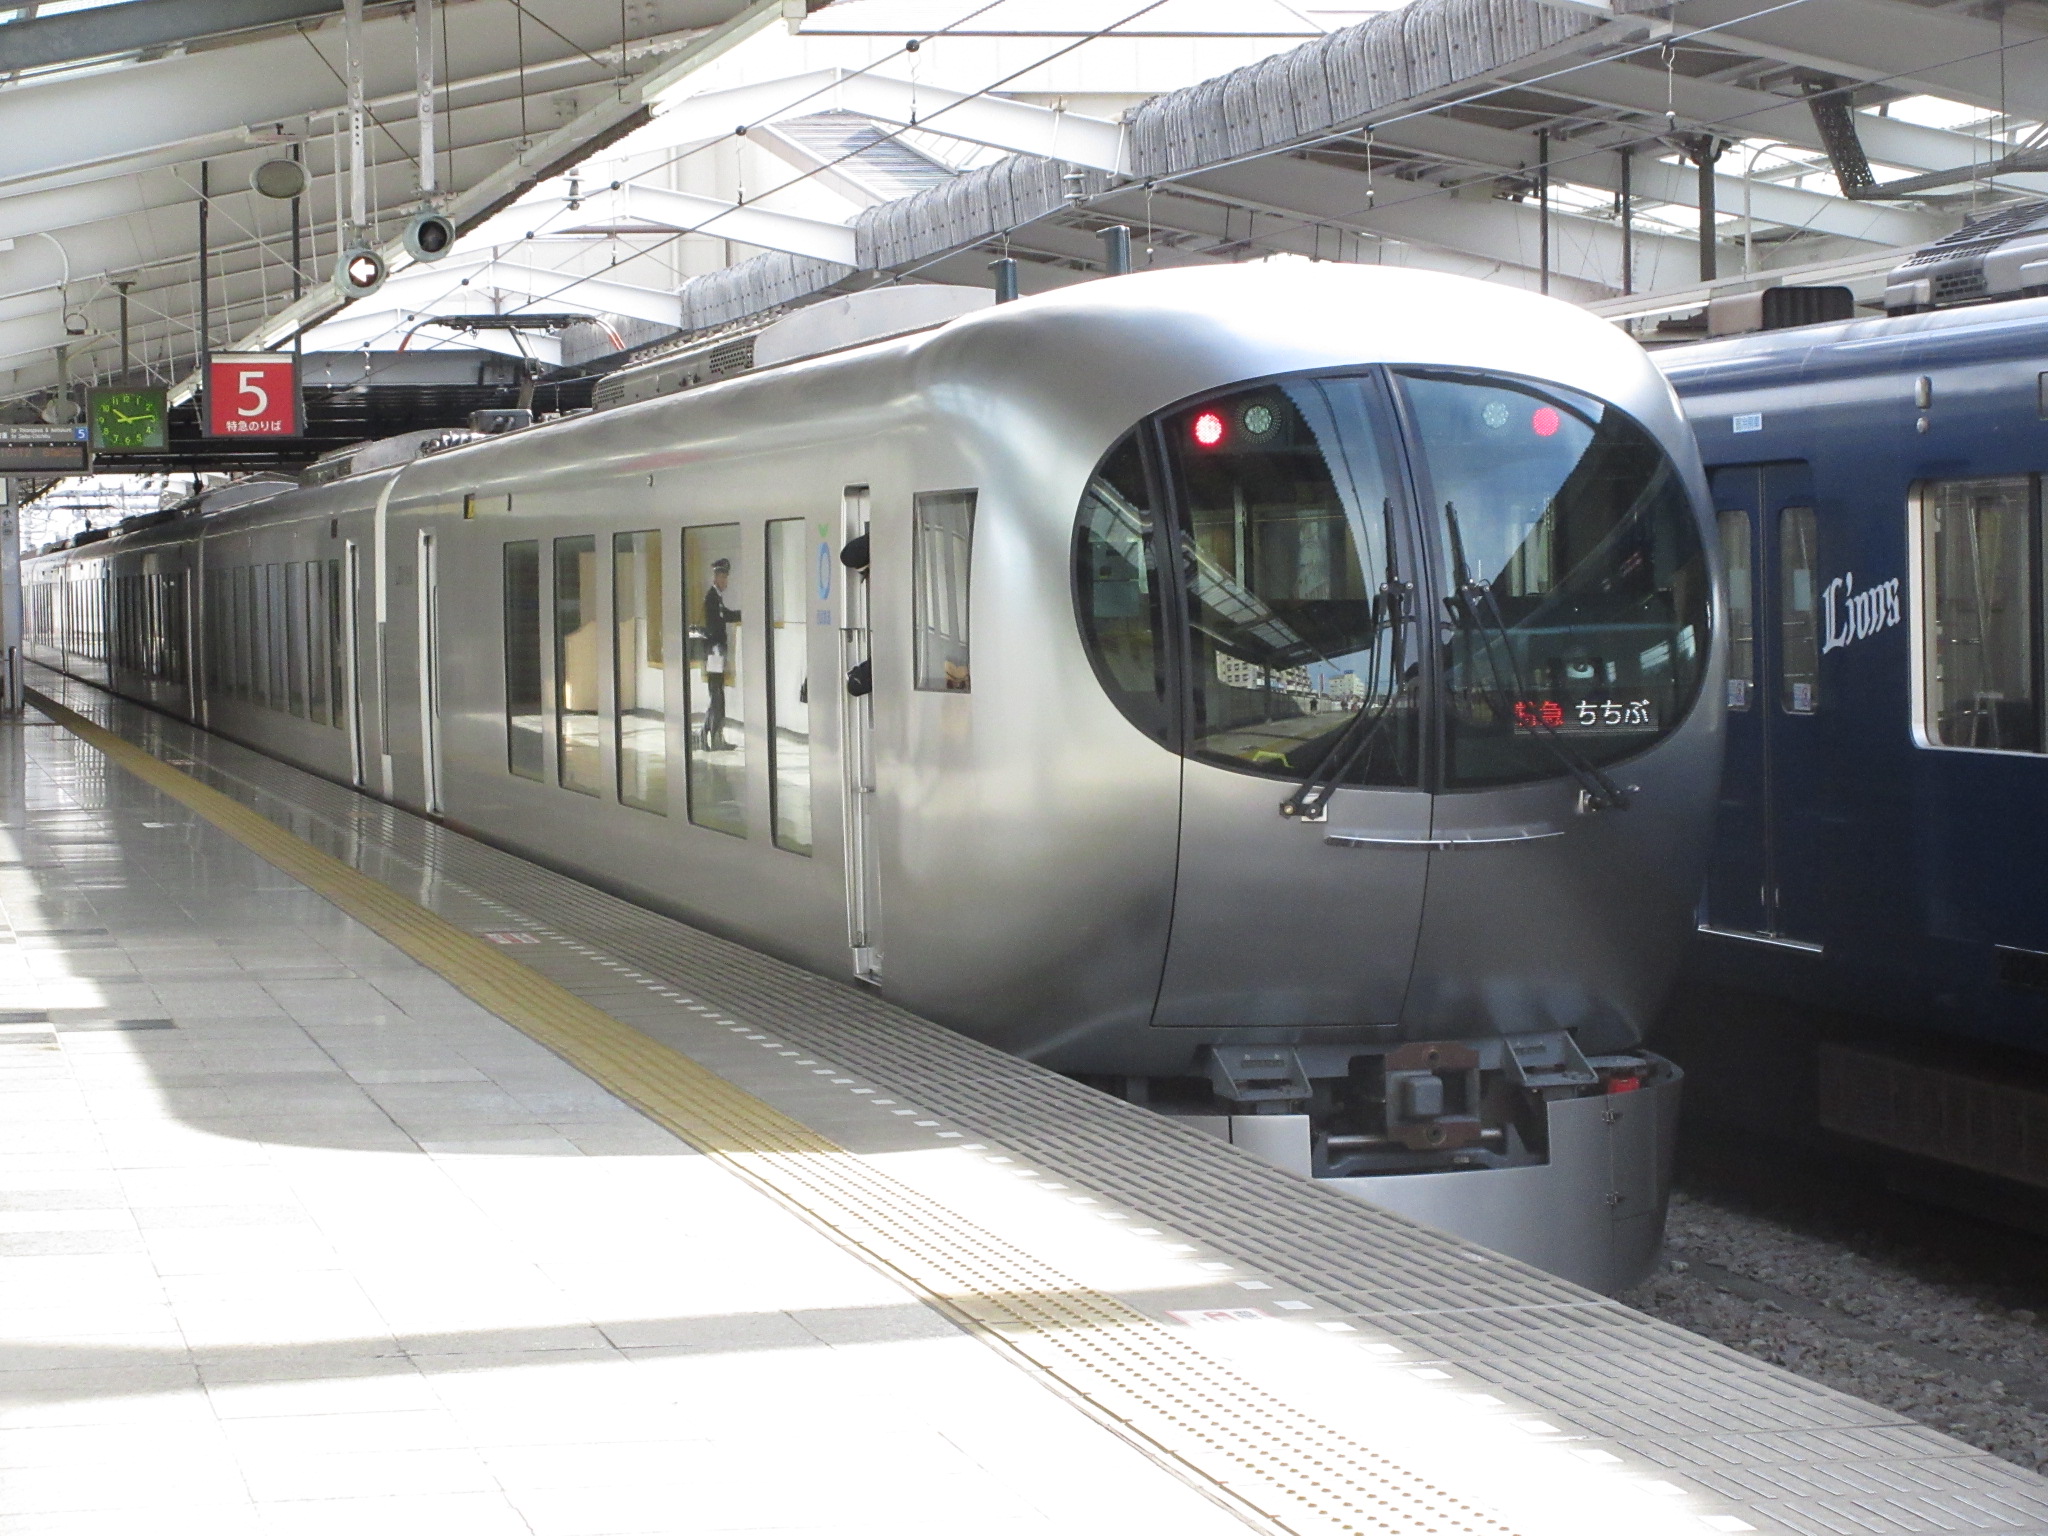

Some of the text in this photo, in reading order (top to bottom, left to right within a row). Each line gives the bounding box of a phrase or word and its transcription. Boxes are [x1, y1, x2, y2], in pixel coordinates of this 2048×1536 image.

[123, 395, 130, 403] 12
[238, 371, 268, 417] 5
[77, 428, 86, 439] 5
[226, 420, 282, 432] 特急のりば
[1822, 571, 1901, 655] Lions
[1575, 699, 1650, 725] ちちぶ
